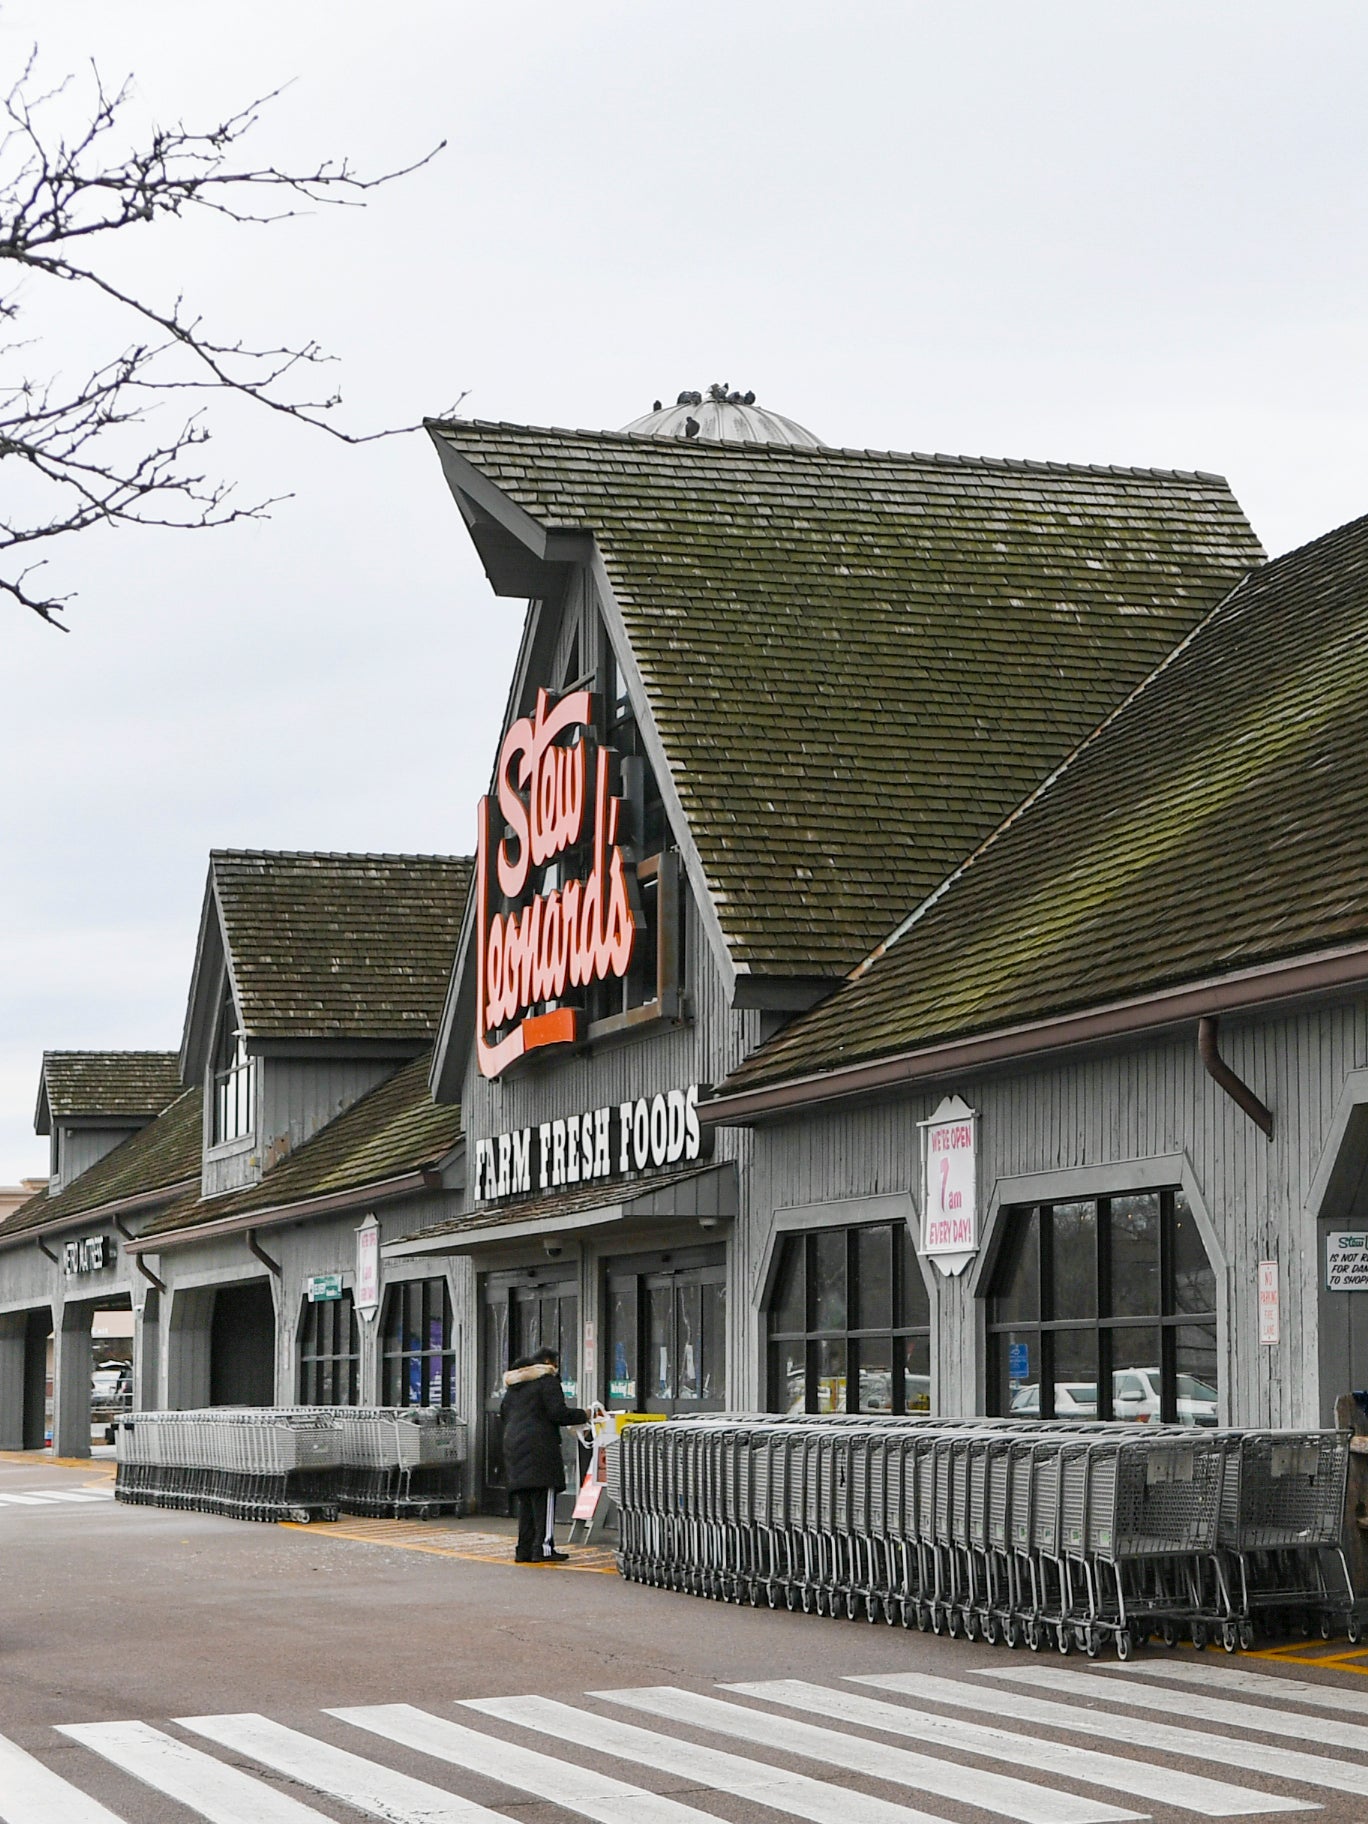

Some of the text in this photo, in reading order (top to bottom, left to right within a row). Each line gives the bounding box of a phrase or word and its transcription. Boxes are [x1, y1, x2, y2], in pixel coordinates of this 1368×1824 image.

[497, 686, 592, 897] Stew
[476, 744, 637, 1079] Leonard's
[474, 1083, 701, 1201] FARM FRESH FOODS
[932, 1124, 972, 1153] WE'RE OPEN
[940, 1156, 962, 1213] 7 am
[929, 1218, 972, 1245] EVERY DAY!
[1338, 1236, 1365, 1249] Stew
[1329, 1253, 1340, 1263] IS
[1341, 1253, 1358, 1263] NOT
[1331, 1264, 1349, 1274] FOR
[1264, 1271, 1273, 1287] NO
[1329, 1275, 1341, 1285] TO
